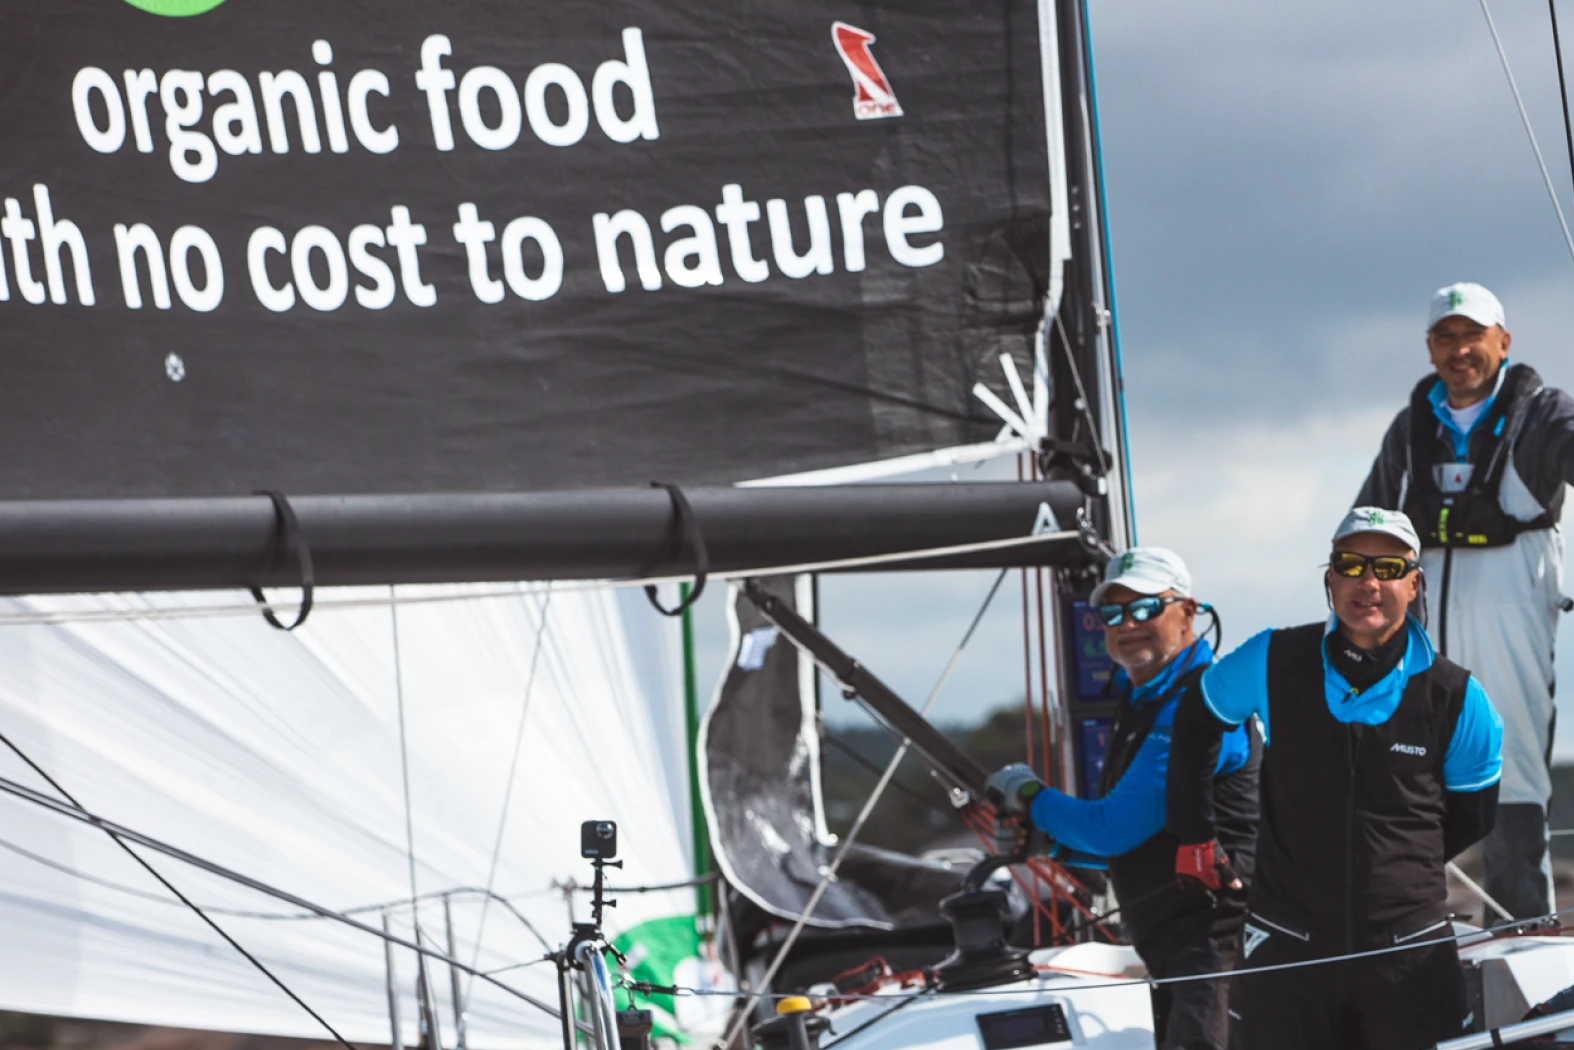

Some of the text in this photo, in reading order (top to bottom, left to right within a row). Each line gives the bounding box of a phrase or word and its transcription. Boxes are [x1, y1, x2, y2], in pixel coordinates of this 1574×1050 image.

[71, 27, 660, 183] organic food
[113, 224, 224, 312] no
[247, 205, 437, 312] cost
[452, 202, 564, 304] to
[592, 183, 944, 293] nature
[1390, 742, 1428, 756] MUSTO
